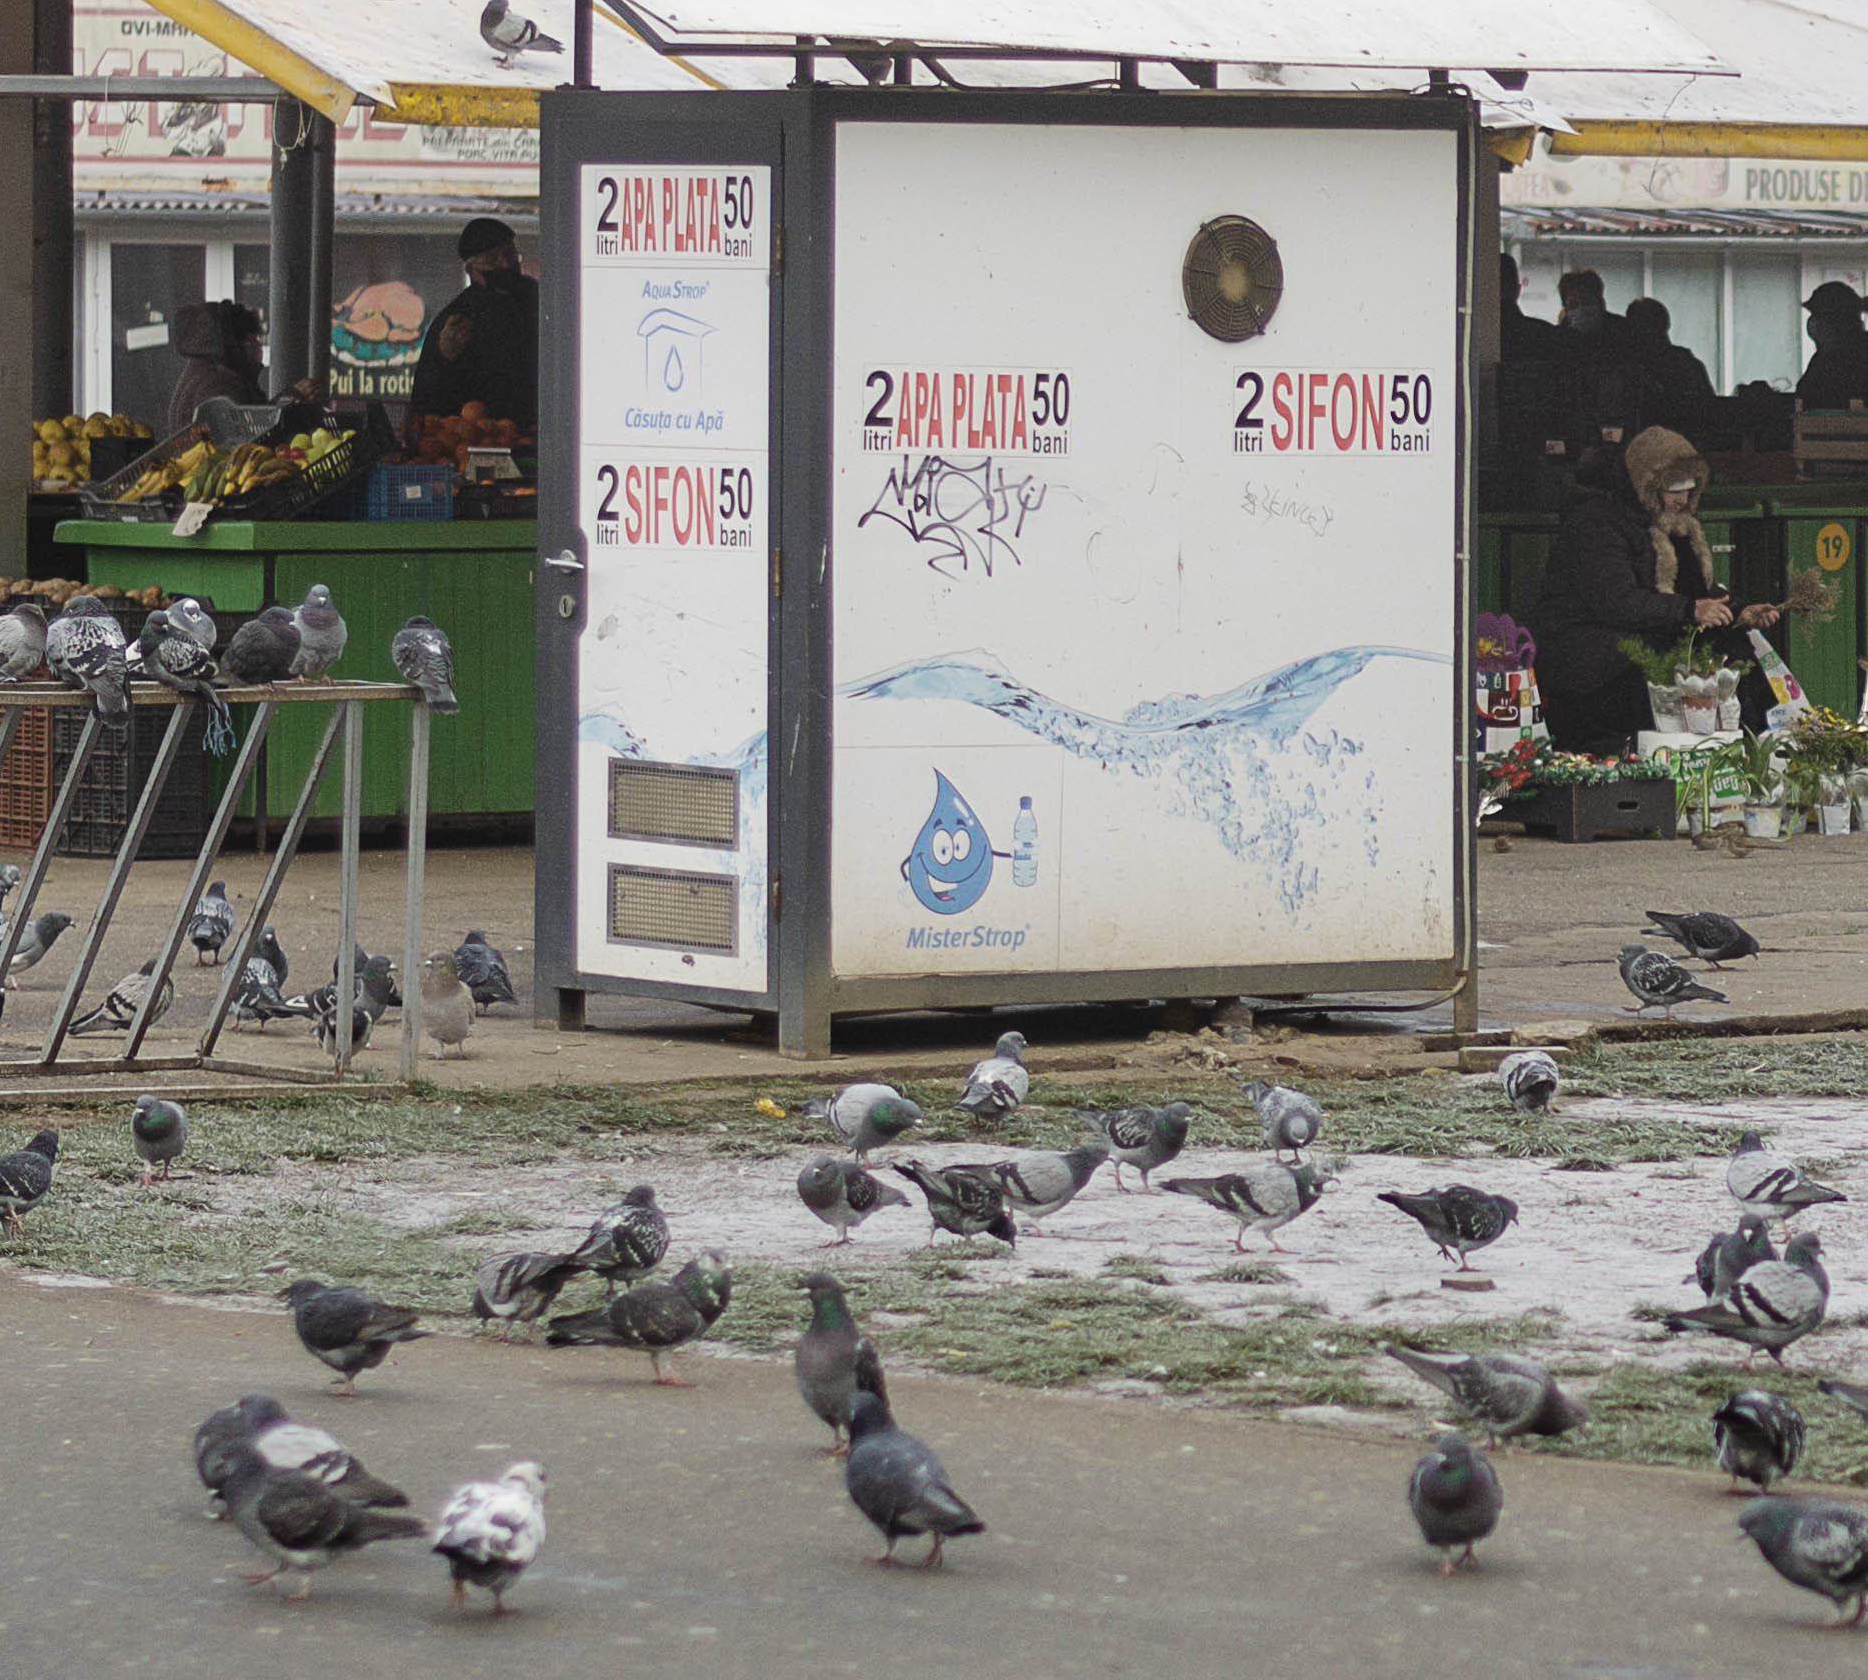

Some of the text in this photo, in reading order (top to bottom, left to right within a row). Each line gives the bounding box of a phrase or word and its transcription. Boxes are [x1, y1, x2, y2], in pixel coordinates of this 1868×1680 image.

[1746, 168, 1868, 203] PRODUSE D
[597, 175, 753, 253] 2 APA PLATA 50
[596, 233, 752, 257] litri bani
[329, 368, 414, 396] Pui la roti
[676, 414, 692, 429] cu
[864, 370, 1069, 450] 2 APA PLATA 50
[1234, 371, 1432, 452] 2 SIFON 50
[864, 429, 1067, 454] litri bani
[1234, 428, 1430, 453] litri bani
[597, 464, 753, 545] 2 SIFON 50
[596, 523, 752, 547] litri bani
[1822, 536, 1843, 559] 19
[905, 925, 1026, 953] MisterStrop
